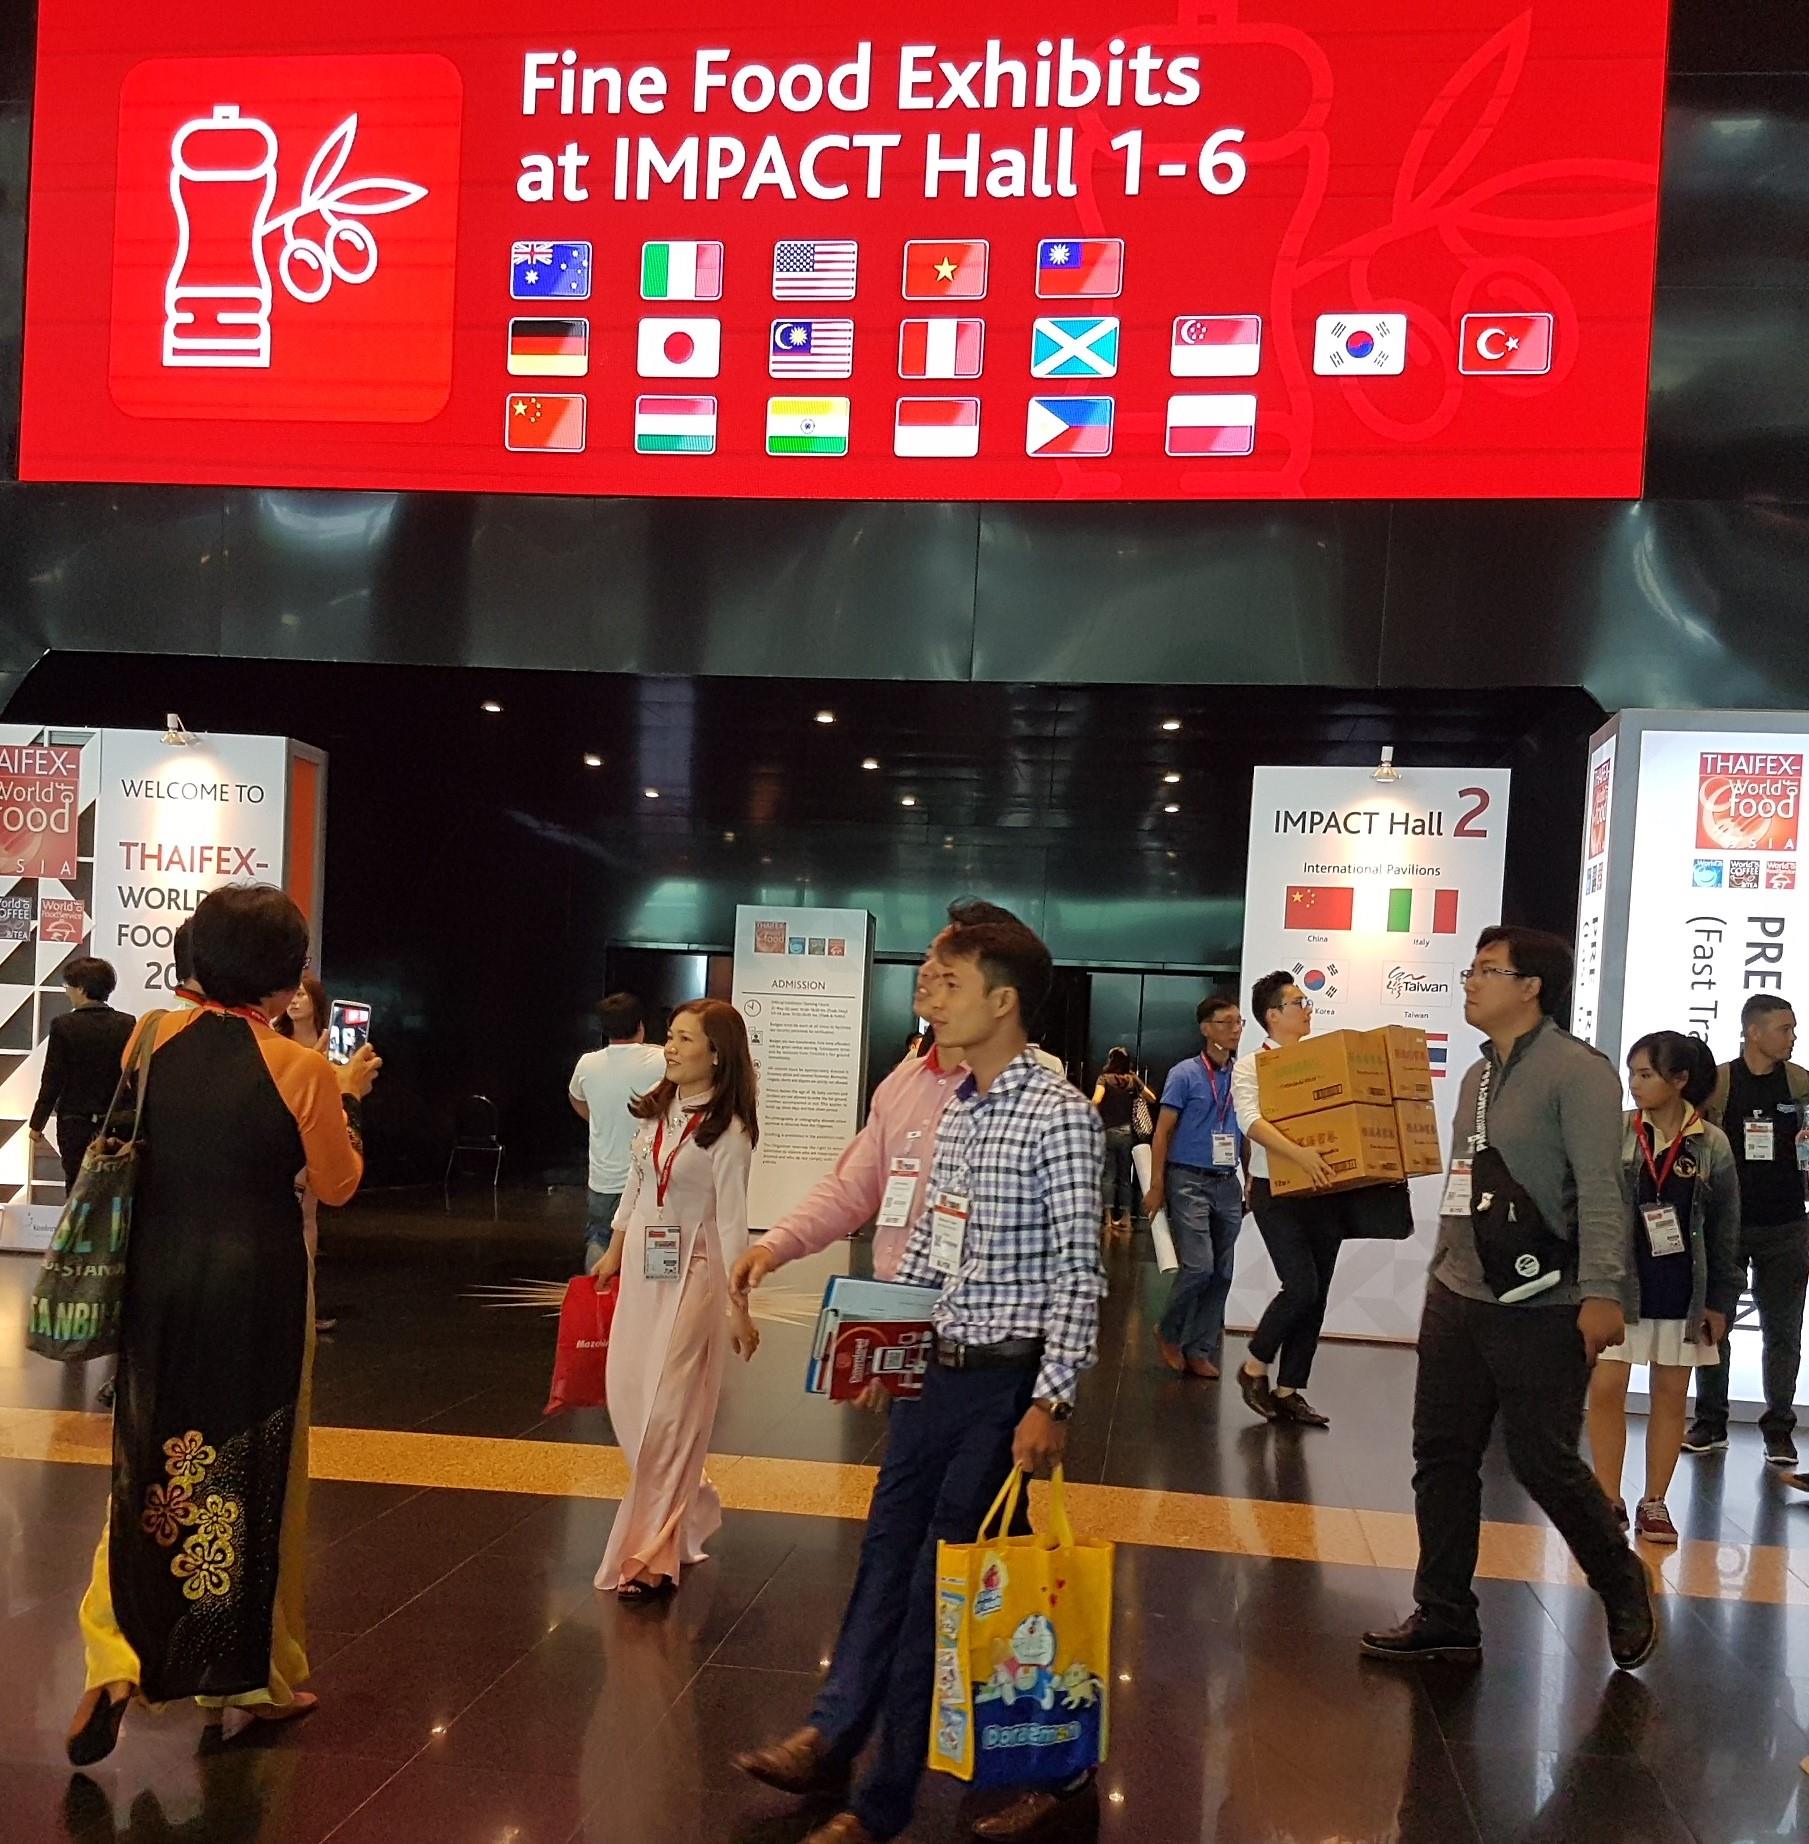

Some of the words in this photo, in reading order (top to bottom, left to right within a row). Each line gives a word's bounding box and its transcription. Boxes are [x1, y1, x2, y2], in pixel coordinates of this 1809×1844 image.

[522, 49, 668, 115] Fine
[693, 41, 872, 114] Food
[898, 37, 1201, 110] Exhibits
[516, 141, 590, 202] at
[613, 133, 902, 201] IMPACT
[924, 127, 1078, 199] Hall
[1110, 127, 1247, 196] 1-6
[1702, 754, 1801, 776] THAIFEX-
[121, 779, 230, 802] WELCOME
[235, 784, 265, 804] TO
[1729, 779, 1782, 796] World
[1274, 810, 1380, 835] IMPACT
[1389, 811, 1444, 836] Hall
[1453, 787, 1491, 838] 2
[1729, 791, 1795, 819] food
[119, 841, 269, 876] THAIFEX-
[1303, 862, 1382, 876] International
[1386, 864, 1442, 877] Pavilions
[0, 898, 21, 909] orld
[42, 900, 73, 912] World
[117, 923, 174, 949] FOO
[1307, 935, 1329, 943] China
[1413, 939, 1431, 948] Italy
[1685, 916, 1727, 990] (Fast
[771, 979, 826, 990] ADMISSION
[1403, 981, 1449, 993] Taiwan
[1314, 1007, 1336, 1016] Korea
[1404, 1011, 1429, 1019] Taiwan
